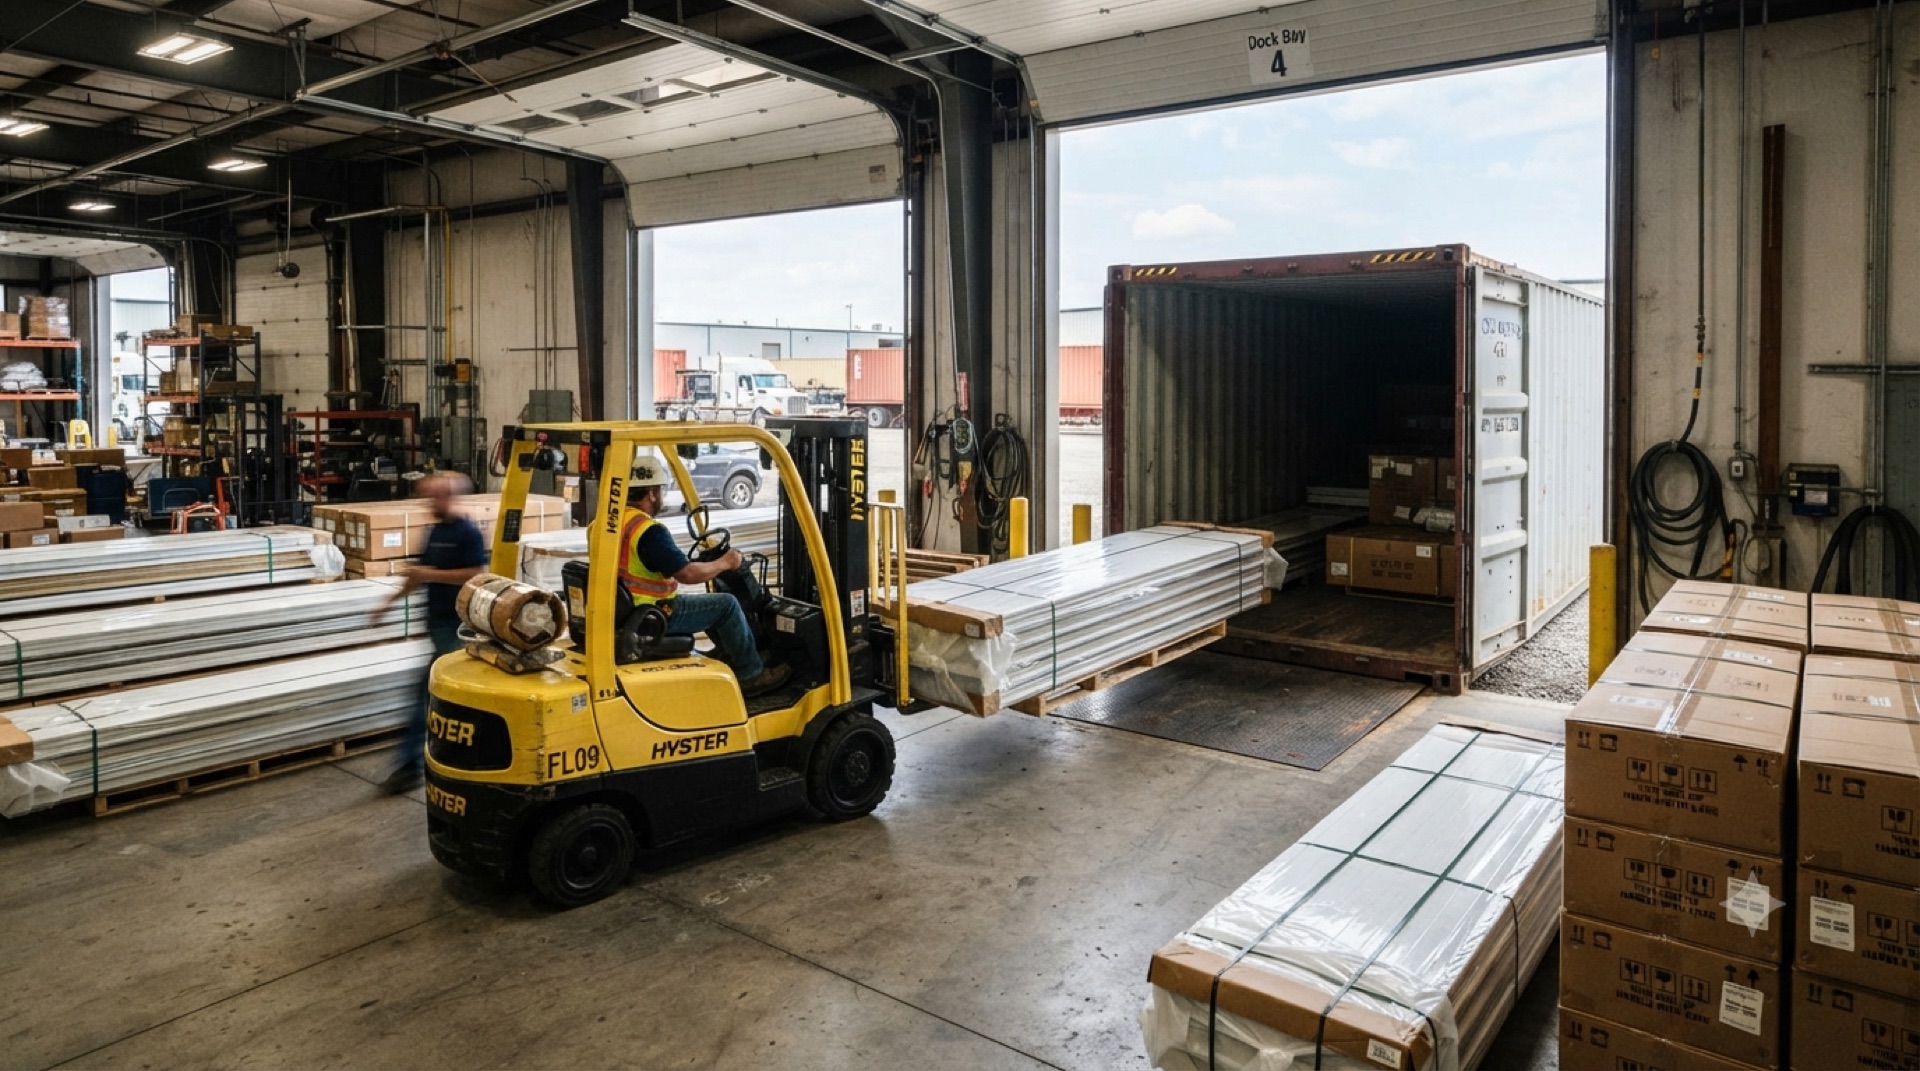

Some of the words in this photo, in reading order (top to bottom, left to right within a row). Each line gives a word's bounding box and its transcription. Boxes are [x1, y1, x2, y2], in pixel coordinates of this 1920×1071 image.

[1248, 32, 1279, 50] Dock
[1271, 49, 1287, 77] 4
[651, 731, 729, 760] HYSTER
[547, 745, 600, 780] FL09
